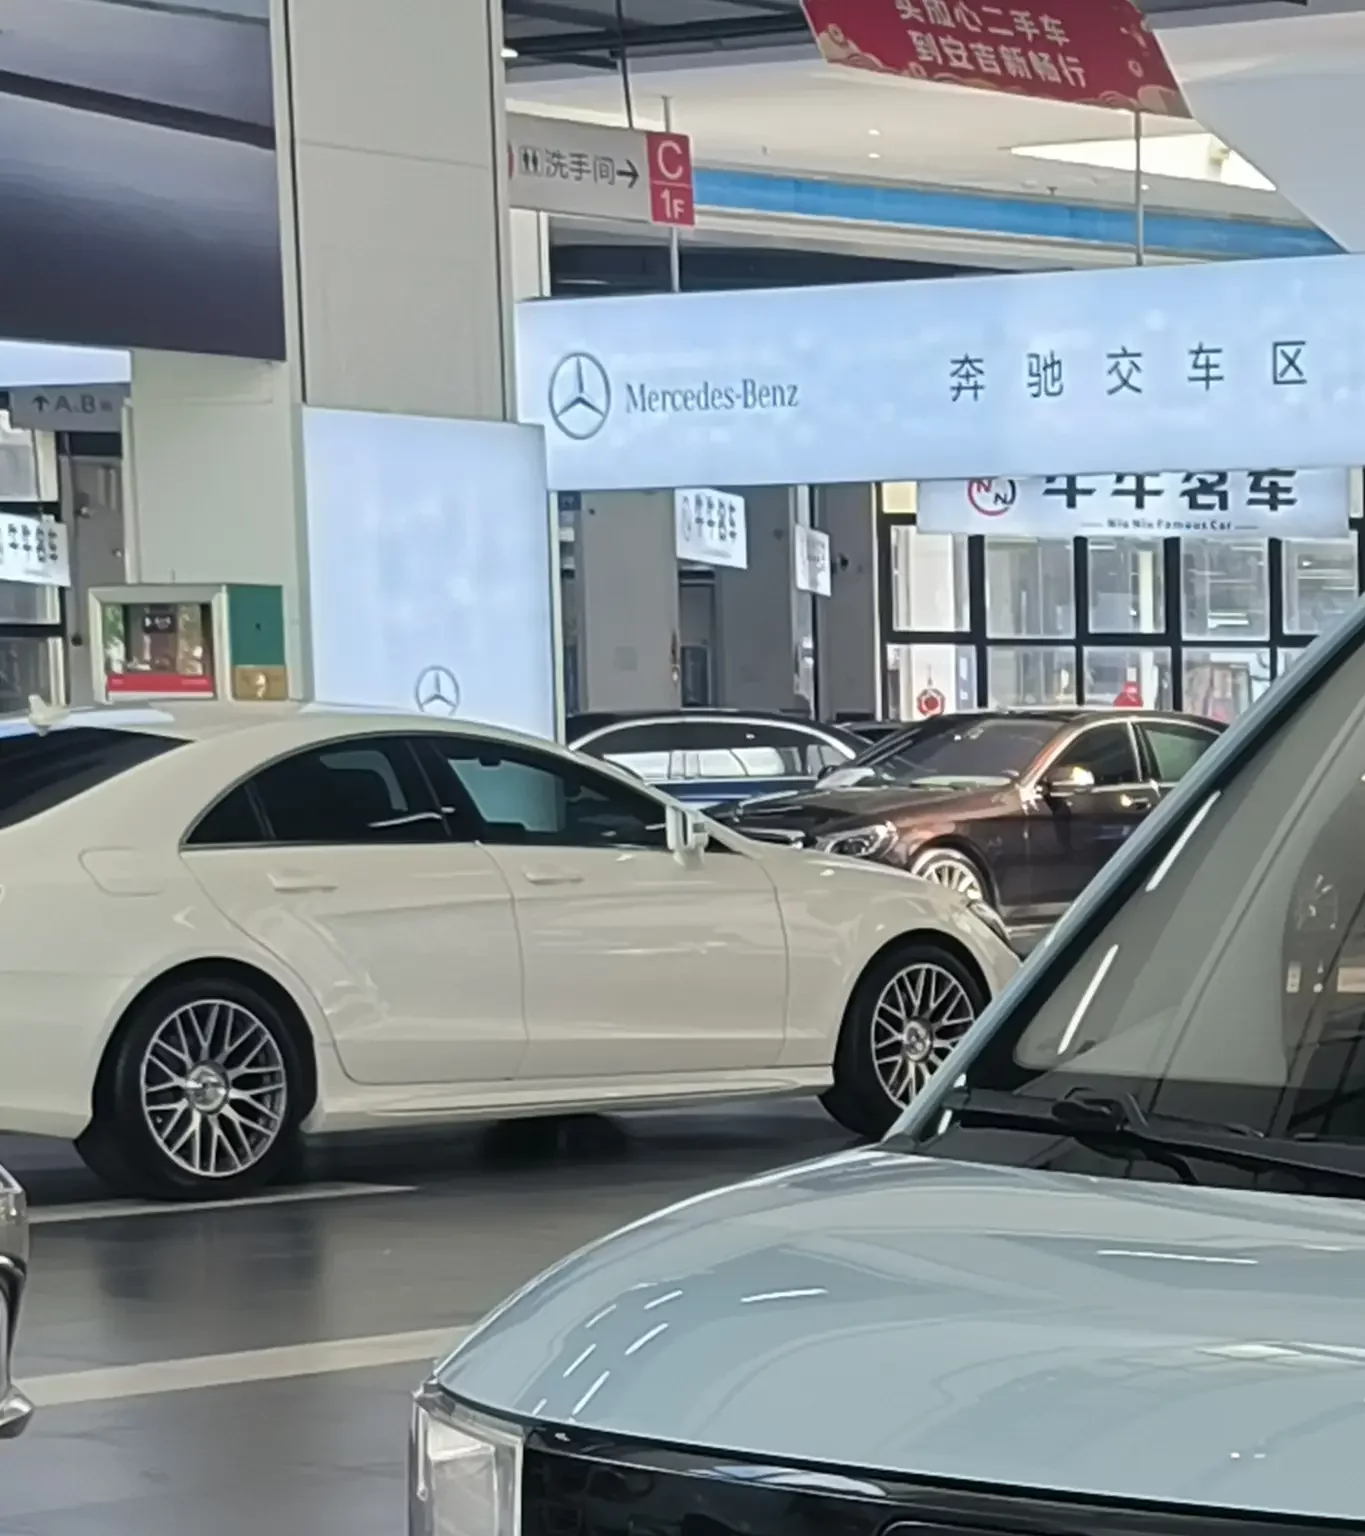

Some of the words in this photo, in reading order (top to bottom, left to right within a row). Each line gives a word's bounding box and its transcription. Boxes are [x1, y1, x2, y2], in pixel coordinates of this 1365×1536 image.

[545, 148, 616, 186] 洗手间
[656, 140, 683, 180] C
[660, 187, 685, 220] 1F
[949, 340, 1308, 403] 奔驰交车区
[625, 378, 799, 414] Mercedes-Benz
